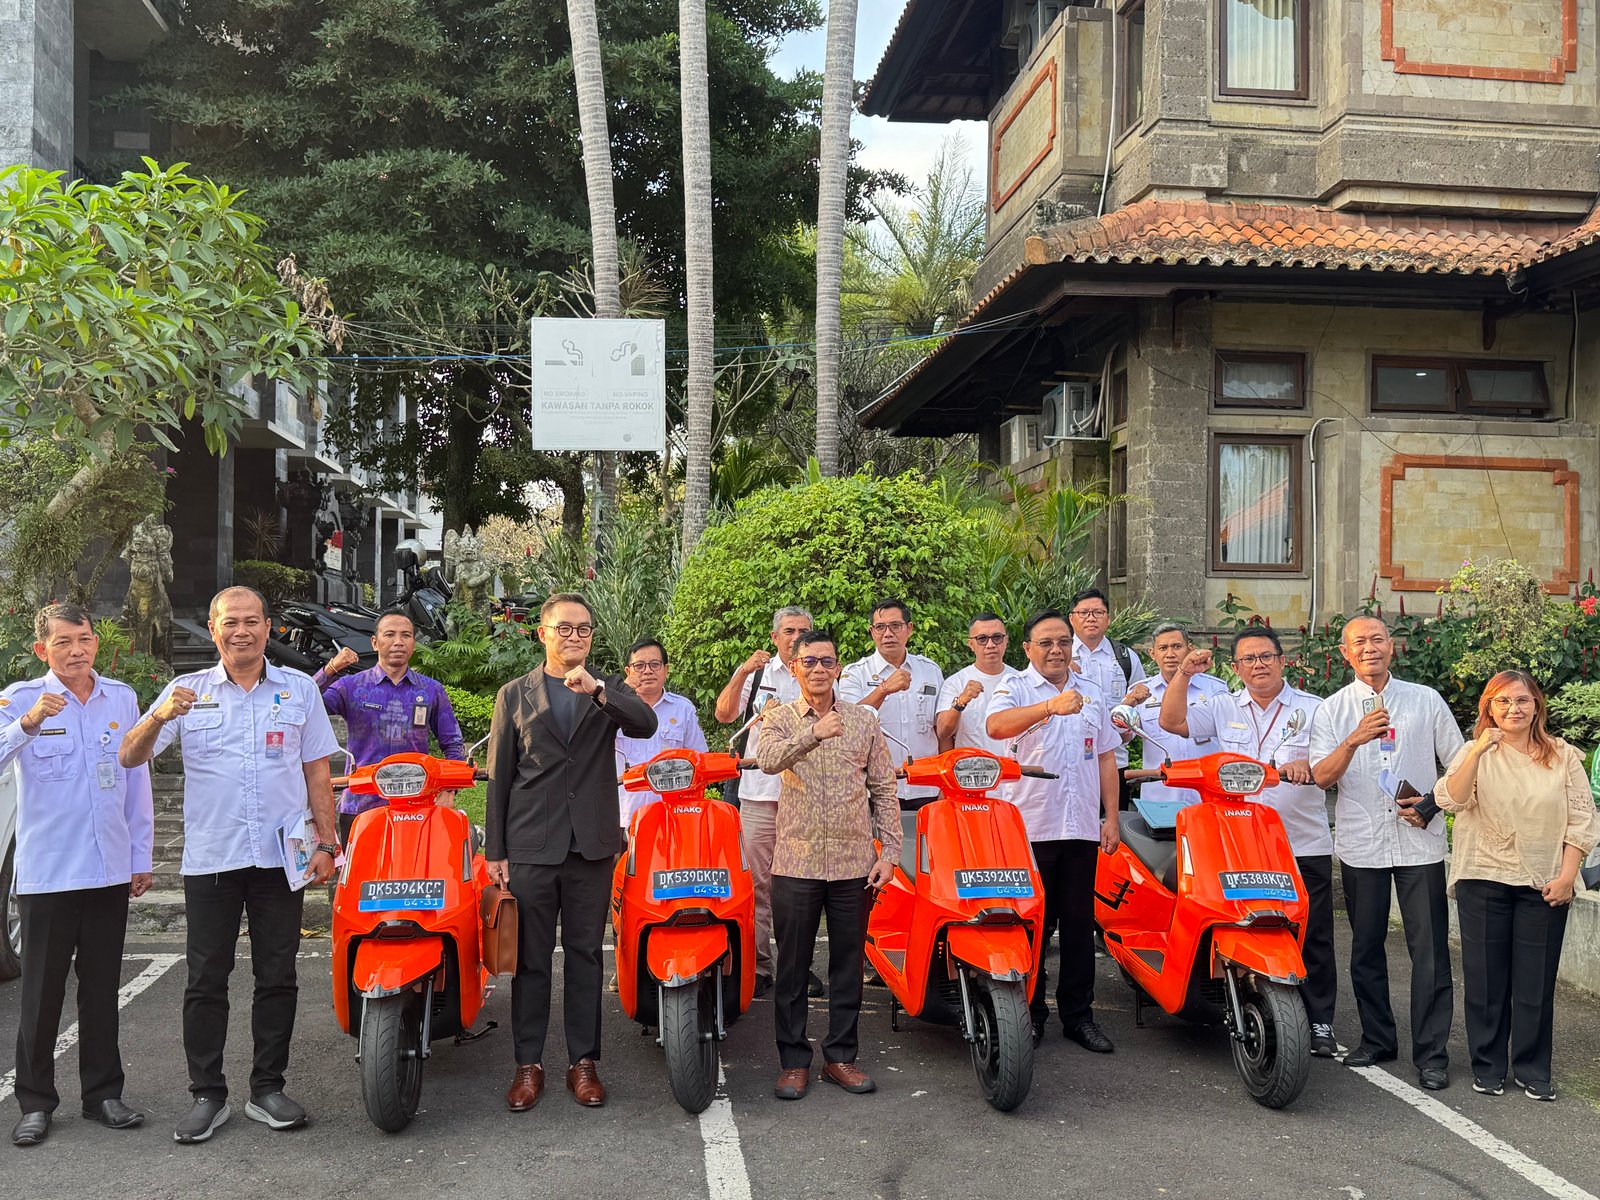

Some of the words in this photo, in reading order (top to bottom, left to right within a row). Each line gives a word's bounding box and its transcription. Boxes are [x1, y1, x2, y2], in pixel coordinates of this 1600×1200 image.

[541, 401, 588, 410] KAWASAN
[590, 402, 620, 410] TANPA
[622, 402, 654, 410] ROKOK
[673, 806, 702, 814] INAKO
[961, 804, 990, 812] INAKO
[1224, 809, 1252, 817] INAKO
[393, 813, 424, 822] INAKO
